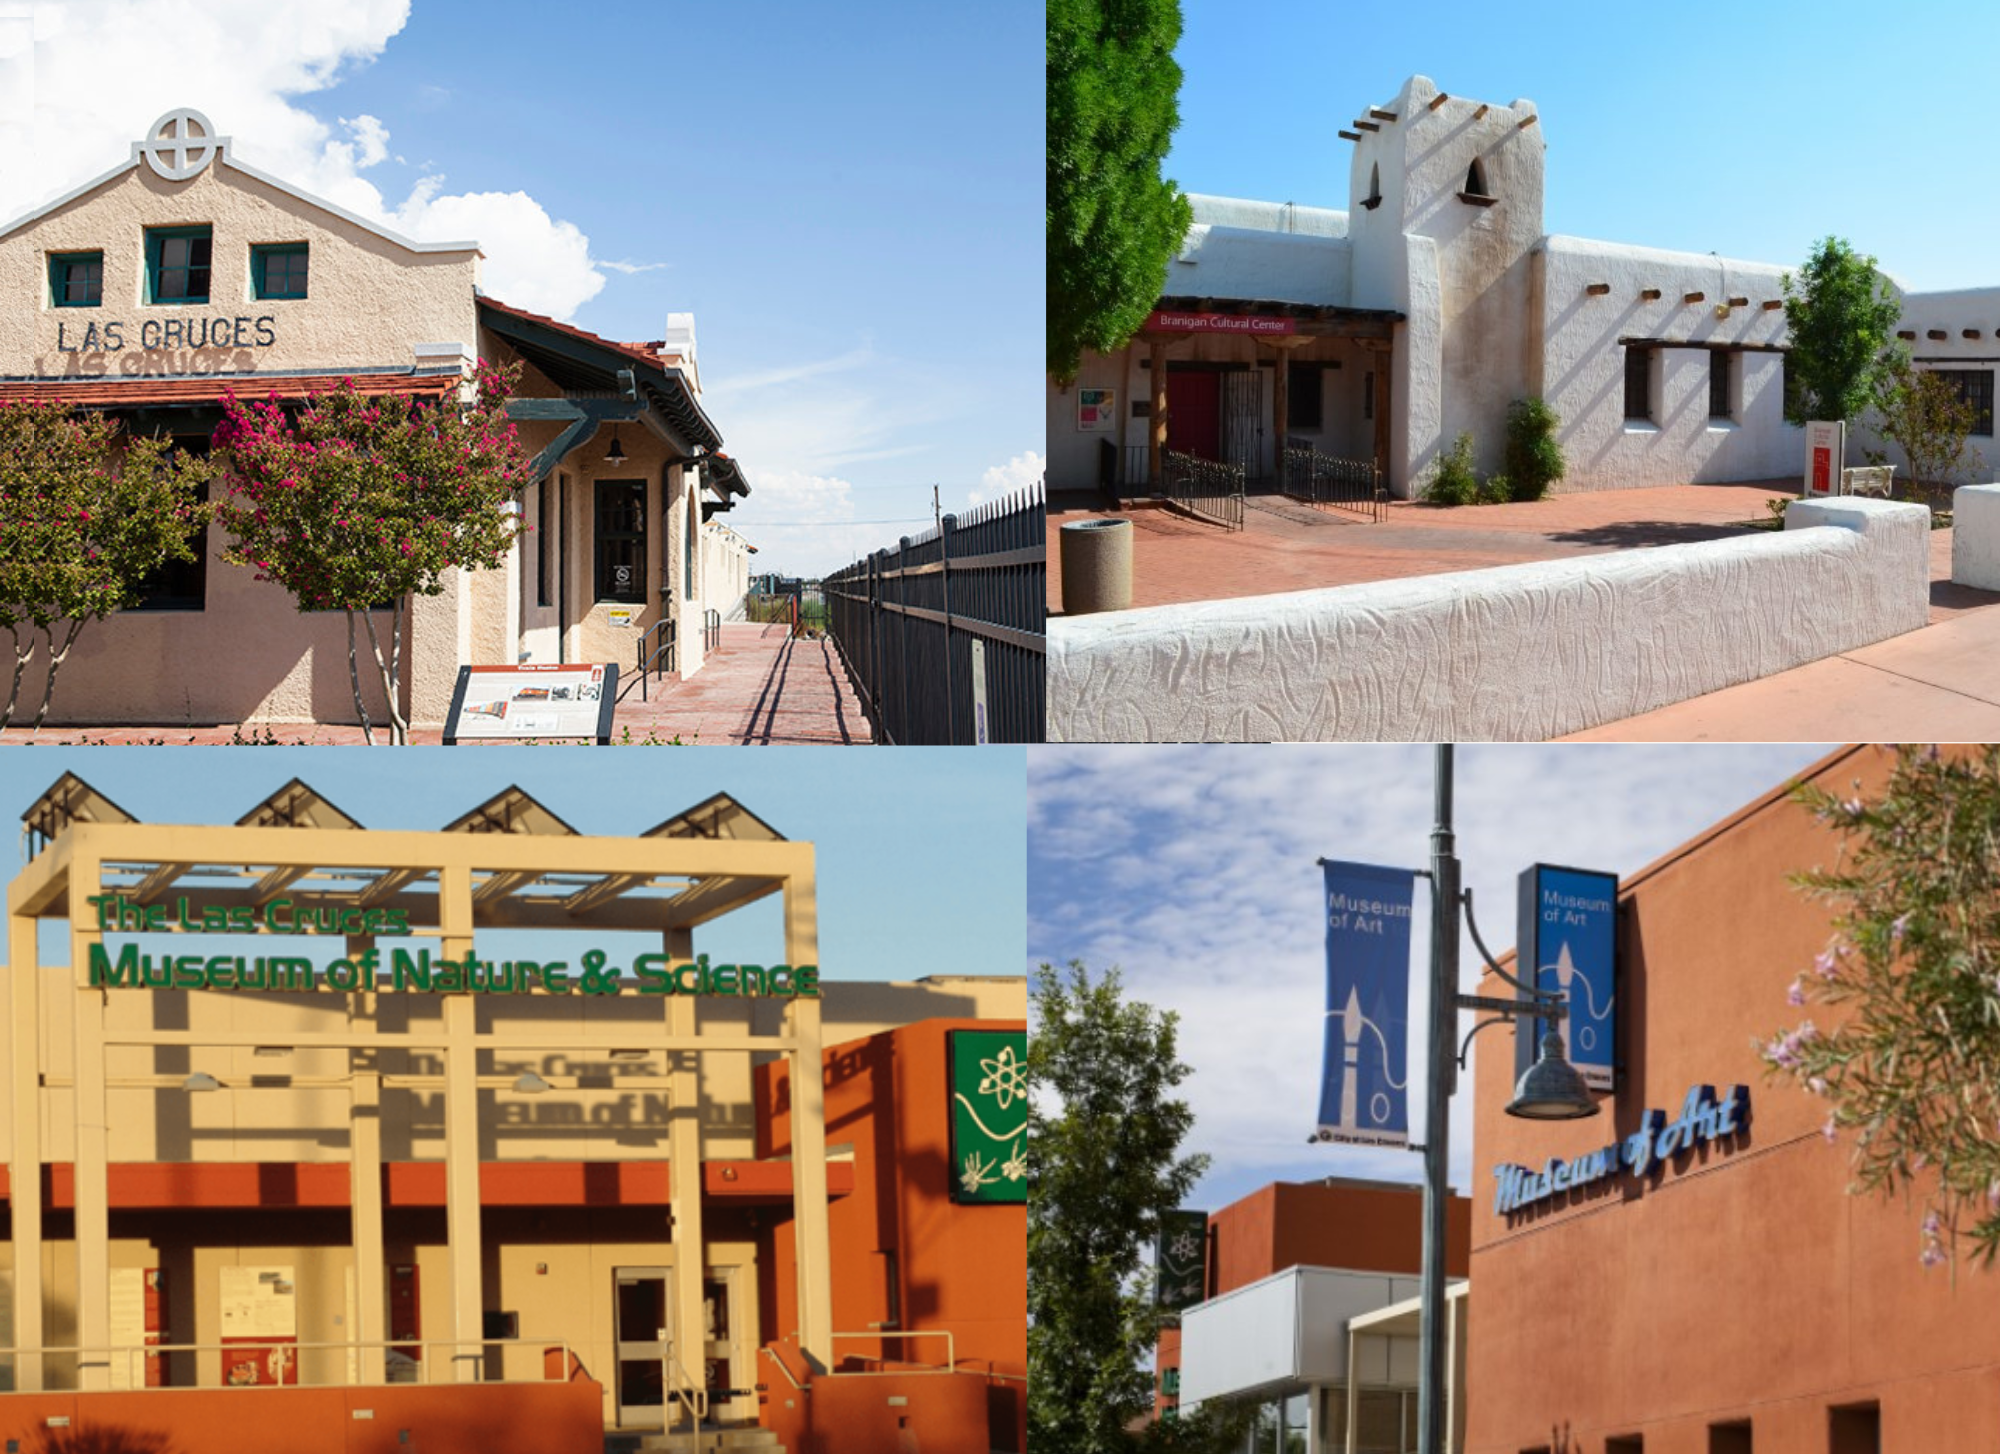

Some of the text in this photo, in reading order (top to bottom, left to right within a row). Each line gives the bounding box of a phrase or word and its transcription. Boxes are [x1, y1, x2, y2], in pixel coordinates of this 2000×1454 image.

[58, 316, 276, 352] LAS CRUCES
[1160, 315, 1285, 330] Branigan Cultural Center
[1329, 892, 1411, 917] Museum
[1543, 890, 1611, 913] Museum
[87, 895, 408, 934] The Las Cruces
[1329, 913, 1383, 935] of Art
[1543, 908, 1587, 926] of Art
[88, 942, 820, 996] Museum of Nature & Science
[1493, 1084, 1741, 1216] Museum of Art
